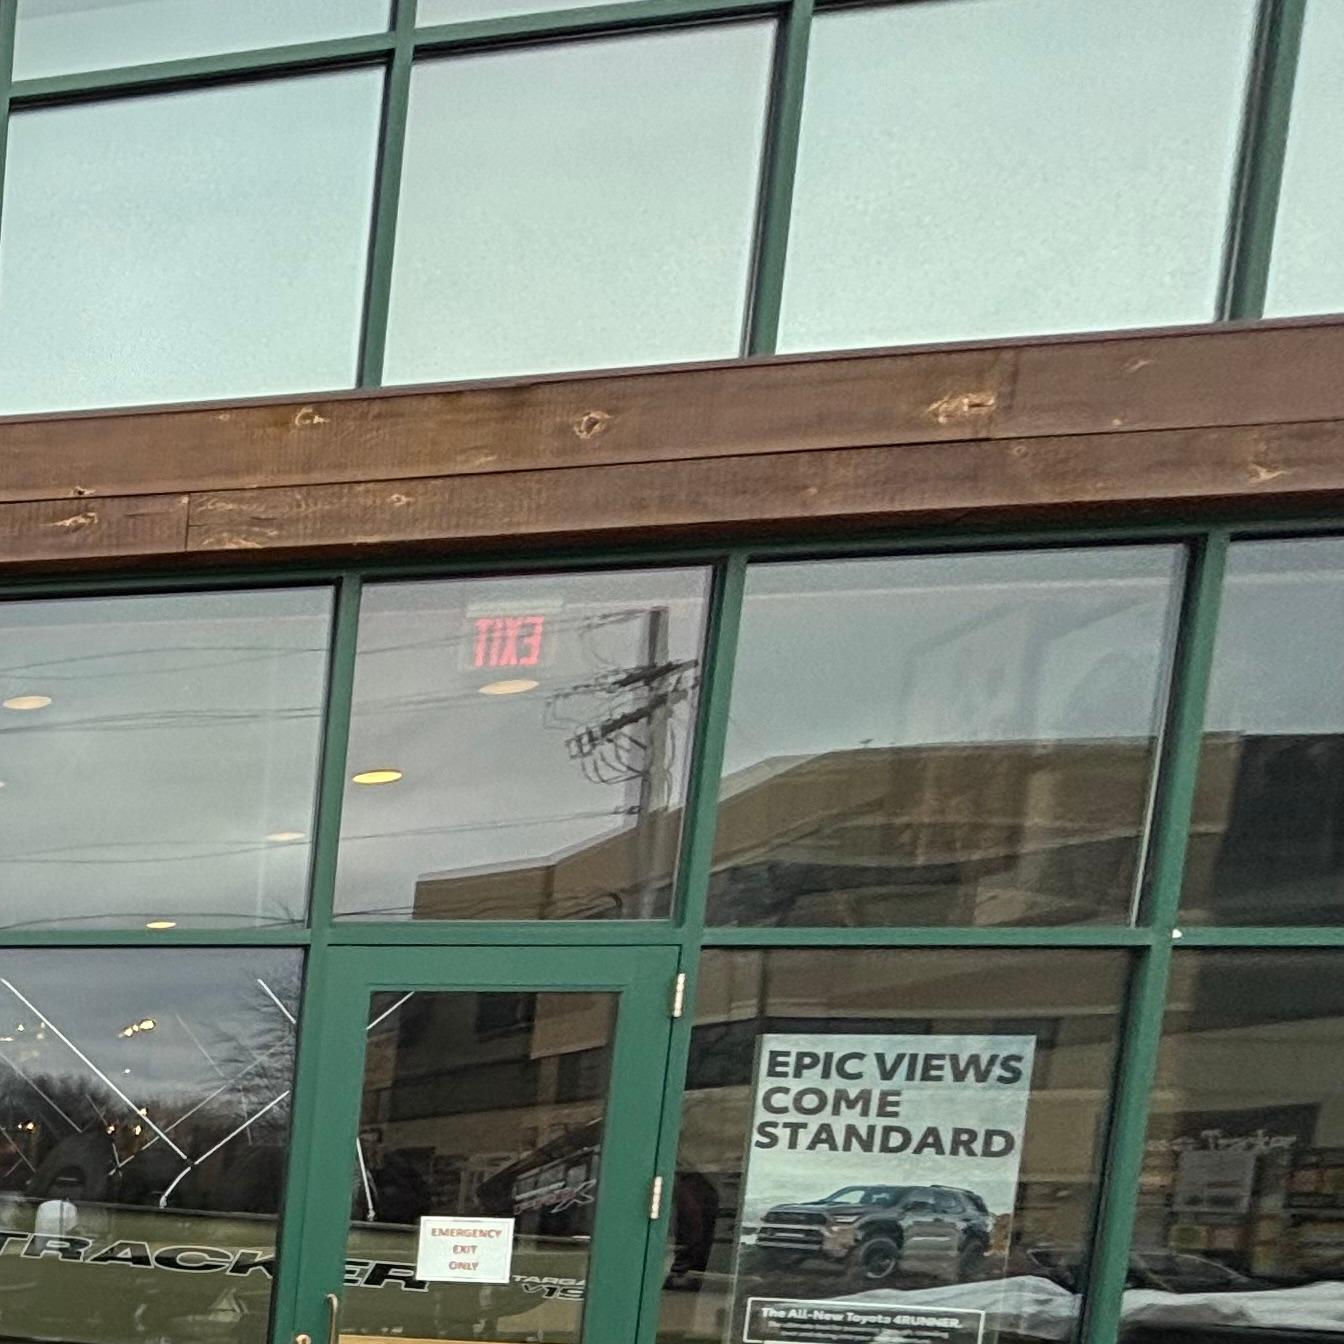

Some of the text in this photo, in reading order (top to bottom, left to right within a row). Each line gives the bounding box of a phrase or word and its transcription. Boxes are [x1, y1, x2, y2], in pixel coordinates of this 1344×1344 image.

[766, 1050, 1025, 1085] EPIC VIEWS
[762, 1086, 903, 1118] COME
[754, 1121, 1017, 1158] STANDARD
[431, 1227, 502, 1239] EMERGENCY
[452, 1244, 478, 1255] EXIT
[448, 1261, 479, 1271] ONLY
[761, 1307, 786, 1318] The
[846, 1312, 892, 1325] Toyota
